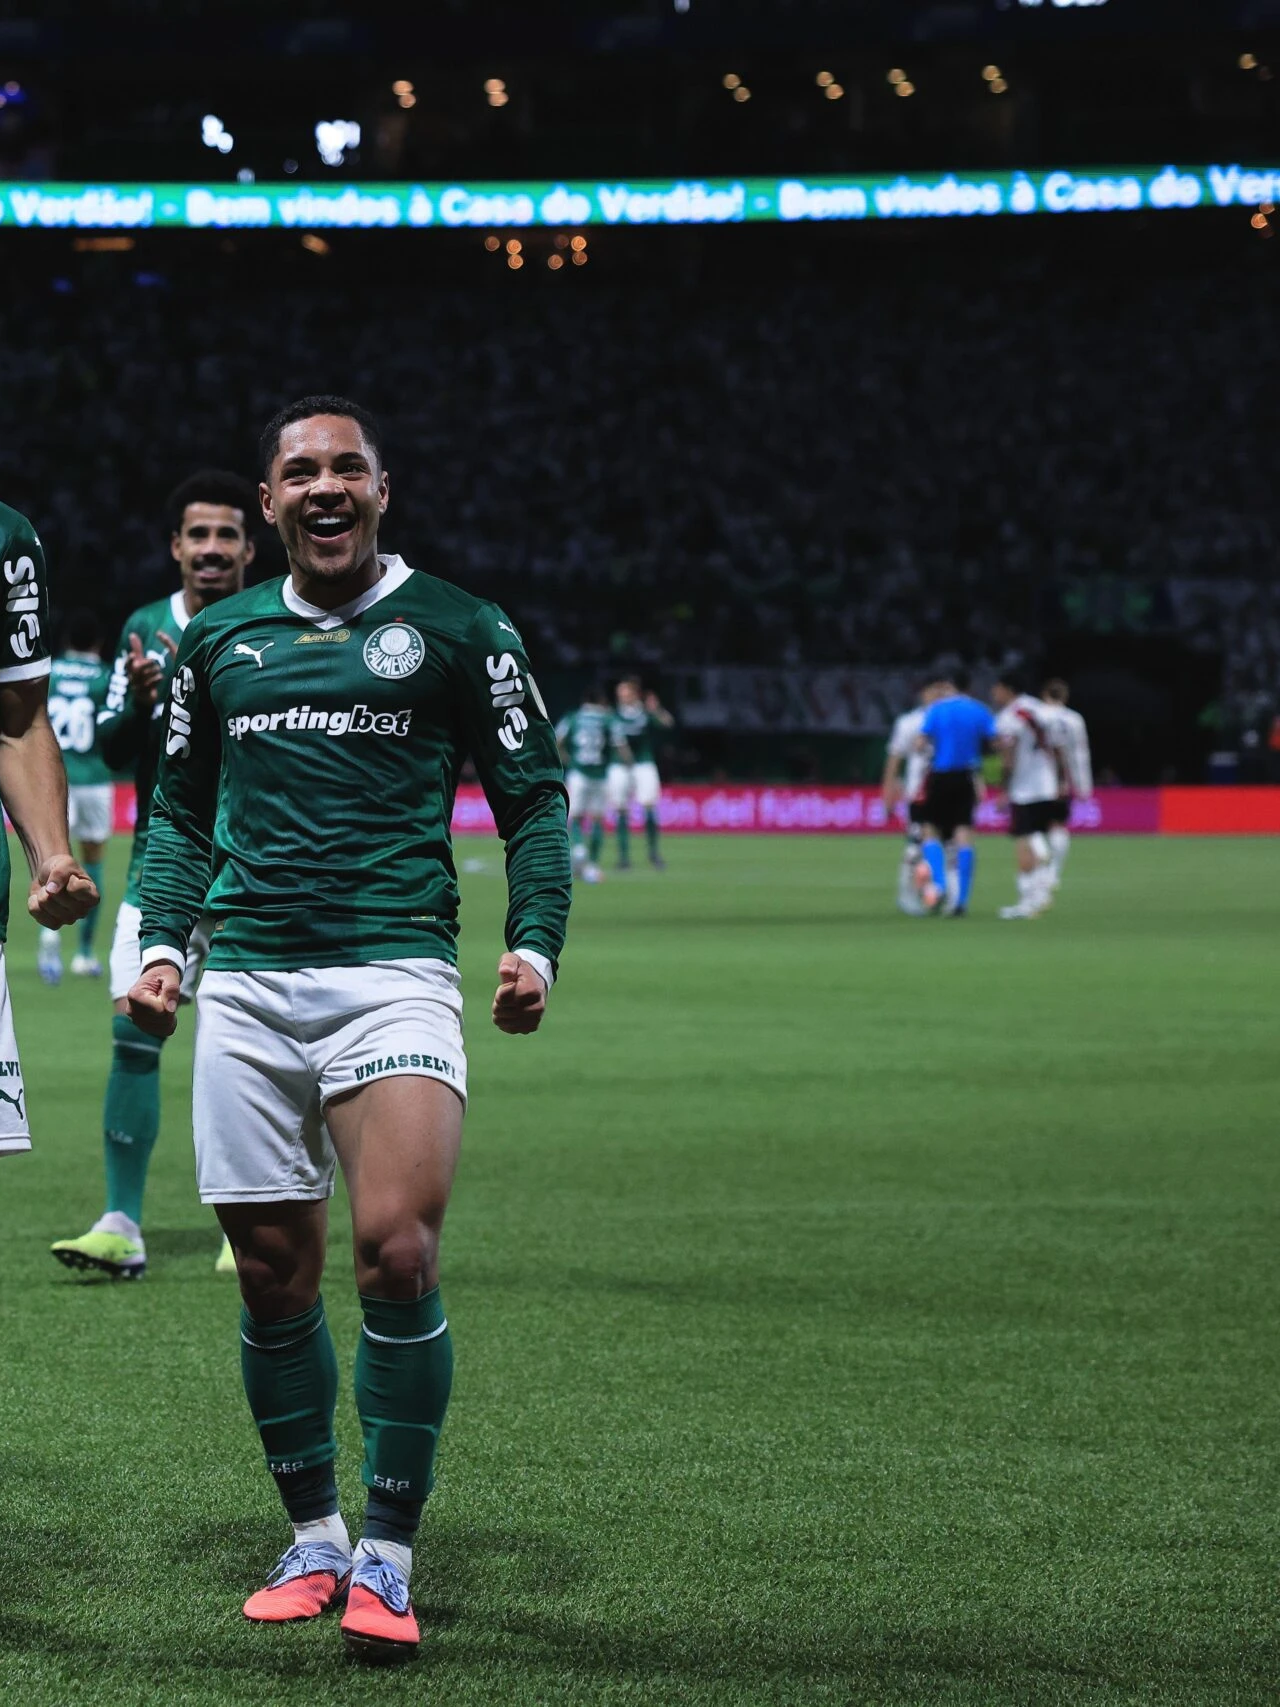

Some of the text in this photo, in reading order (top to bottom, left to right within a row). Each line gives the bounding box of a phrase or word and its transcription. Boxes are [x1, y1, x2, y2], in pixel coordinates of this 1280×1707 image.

[185, 187, 271, 227] Bem
[277, 184, 401, 227] vindos
[439, 185, 534, 226] Casa
[541, 183, 592, 225] do
[779, 180, 867, 221] Bem
[874, 174, 1002, 217] vindos
[1043, 170, 1142, 212] Casa
[1148, 165, 1202, 208] do
[367, 646, 421, 676] PALMEIRAS
[227, 704, 413, 740] sportingbet
[354, 1053, 457, 1082] UNIASSELVI
